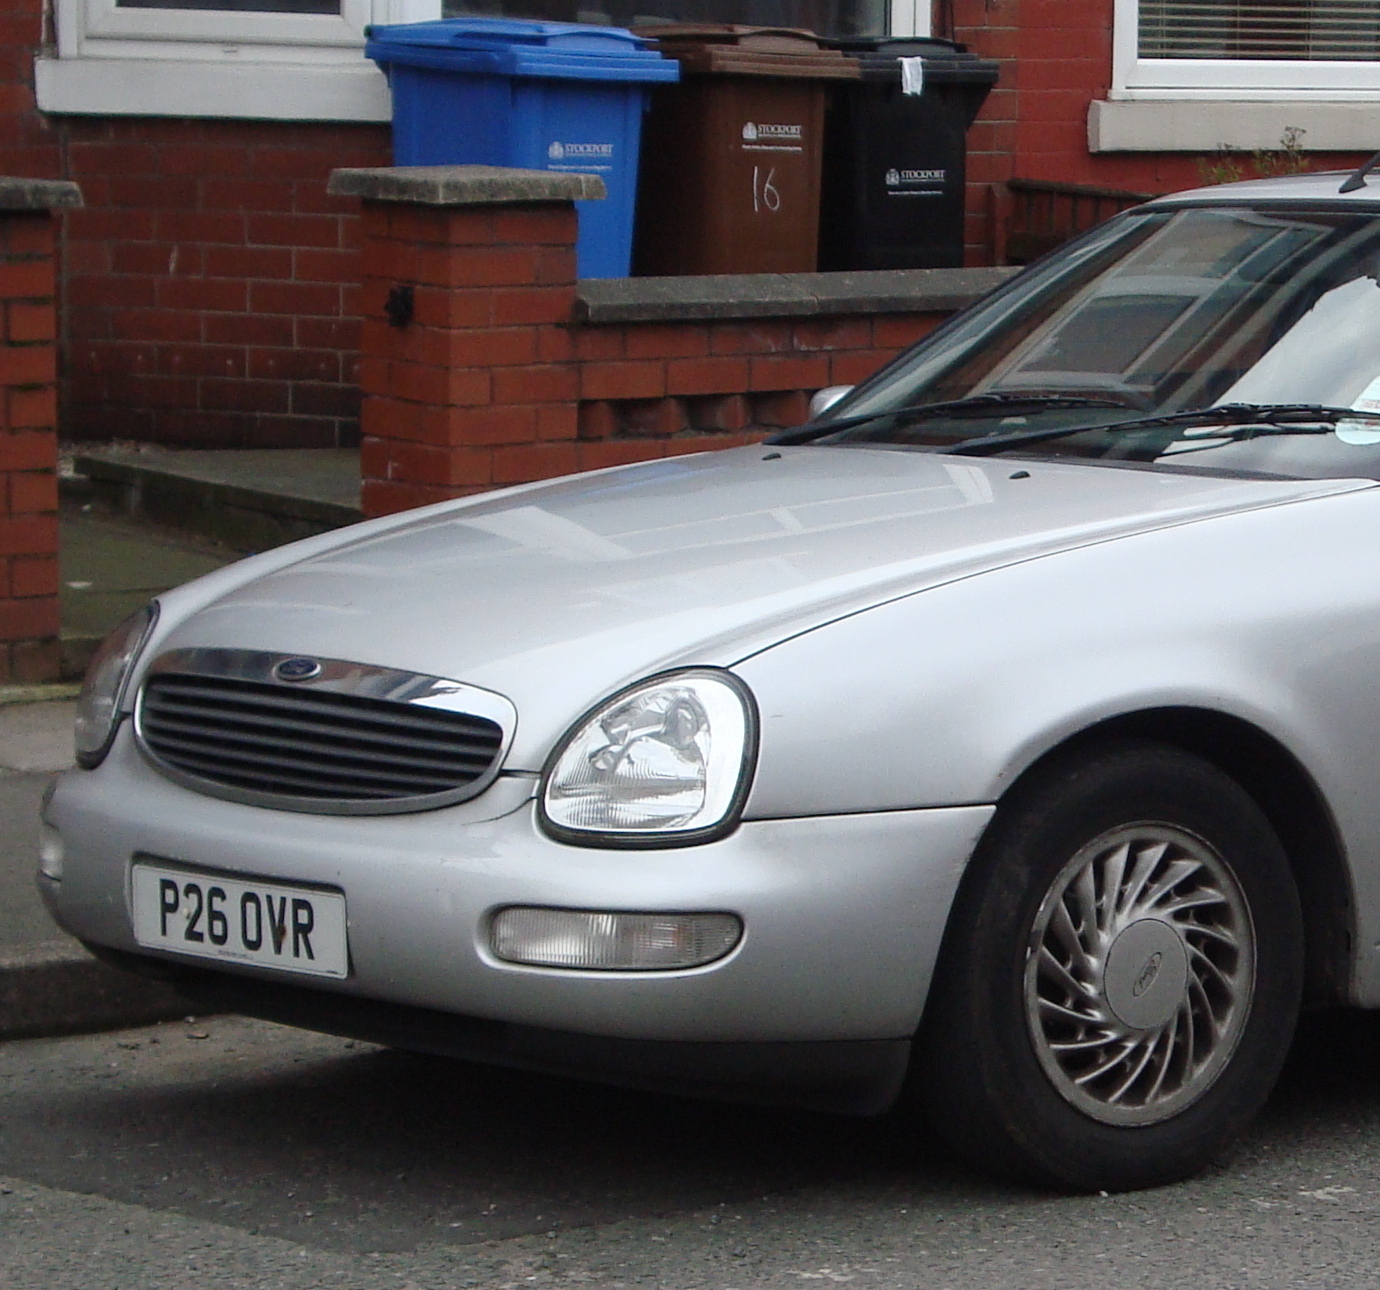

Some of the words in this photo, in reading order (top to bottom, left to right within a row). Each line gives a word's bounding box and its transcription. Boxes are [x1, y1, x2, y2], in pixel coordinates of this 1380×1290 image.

[565, 144, 614, 153] STOCKPORT
[901, 170, 945, 178] STOCKPORT
[753, 166, 780, 212] 16
[159, 878, 228, 946] P26
[240, 891, 315, 961] OVR
